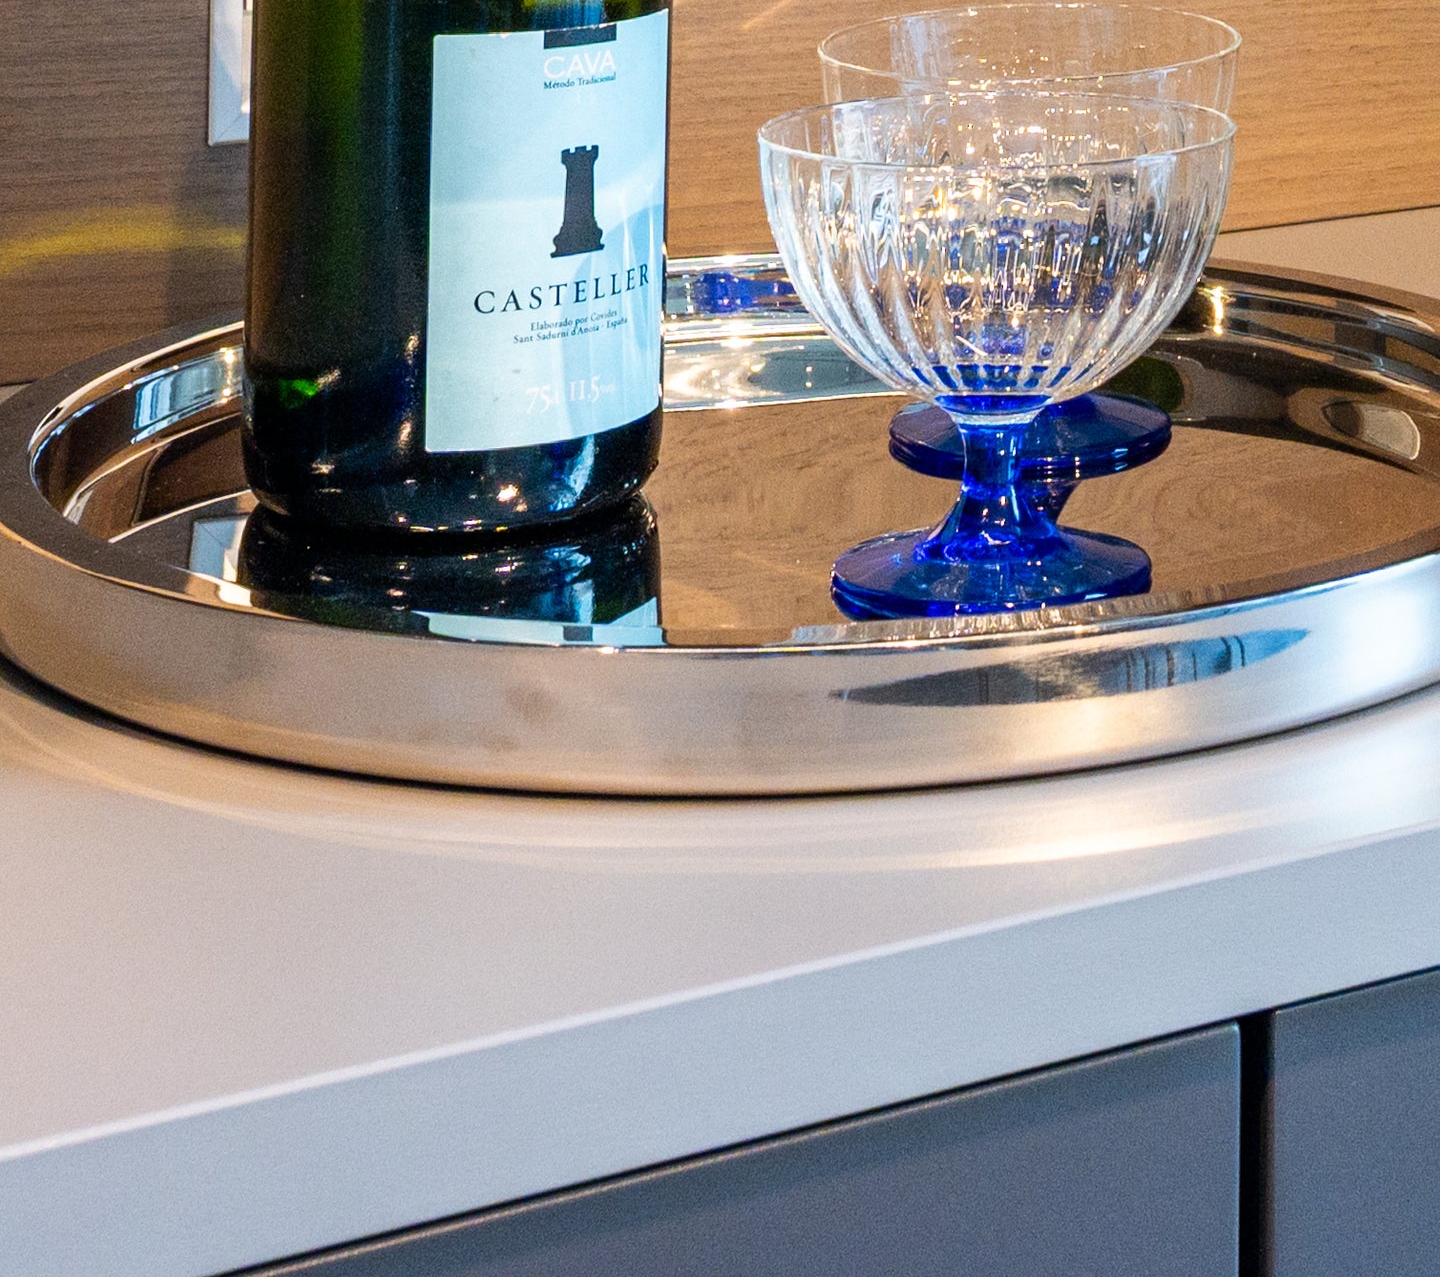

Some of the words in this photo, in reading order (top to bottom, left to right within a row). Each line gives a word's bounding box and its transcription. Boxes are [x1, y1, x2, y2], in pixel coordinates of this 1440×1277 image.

[543, 49, 617, 79] CAVA
[473, 263, 649, 315] CASTELLER
[530, 317, 573, 332] Elaborado
[574, 316, 589, 329] por
[513, 333, 534, 344] Sant
